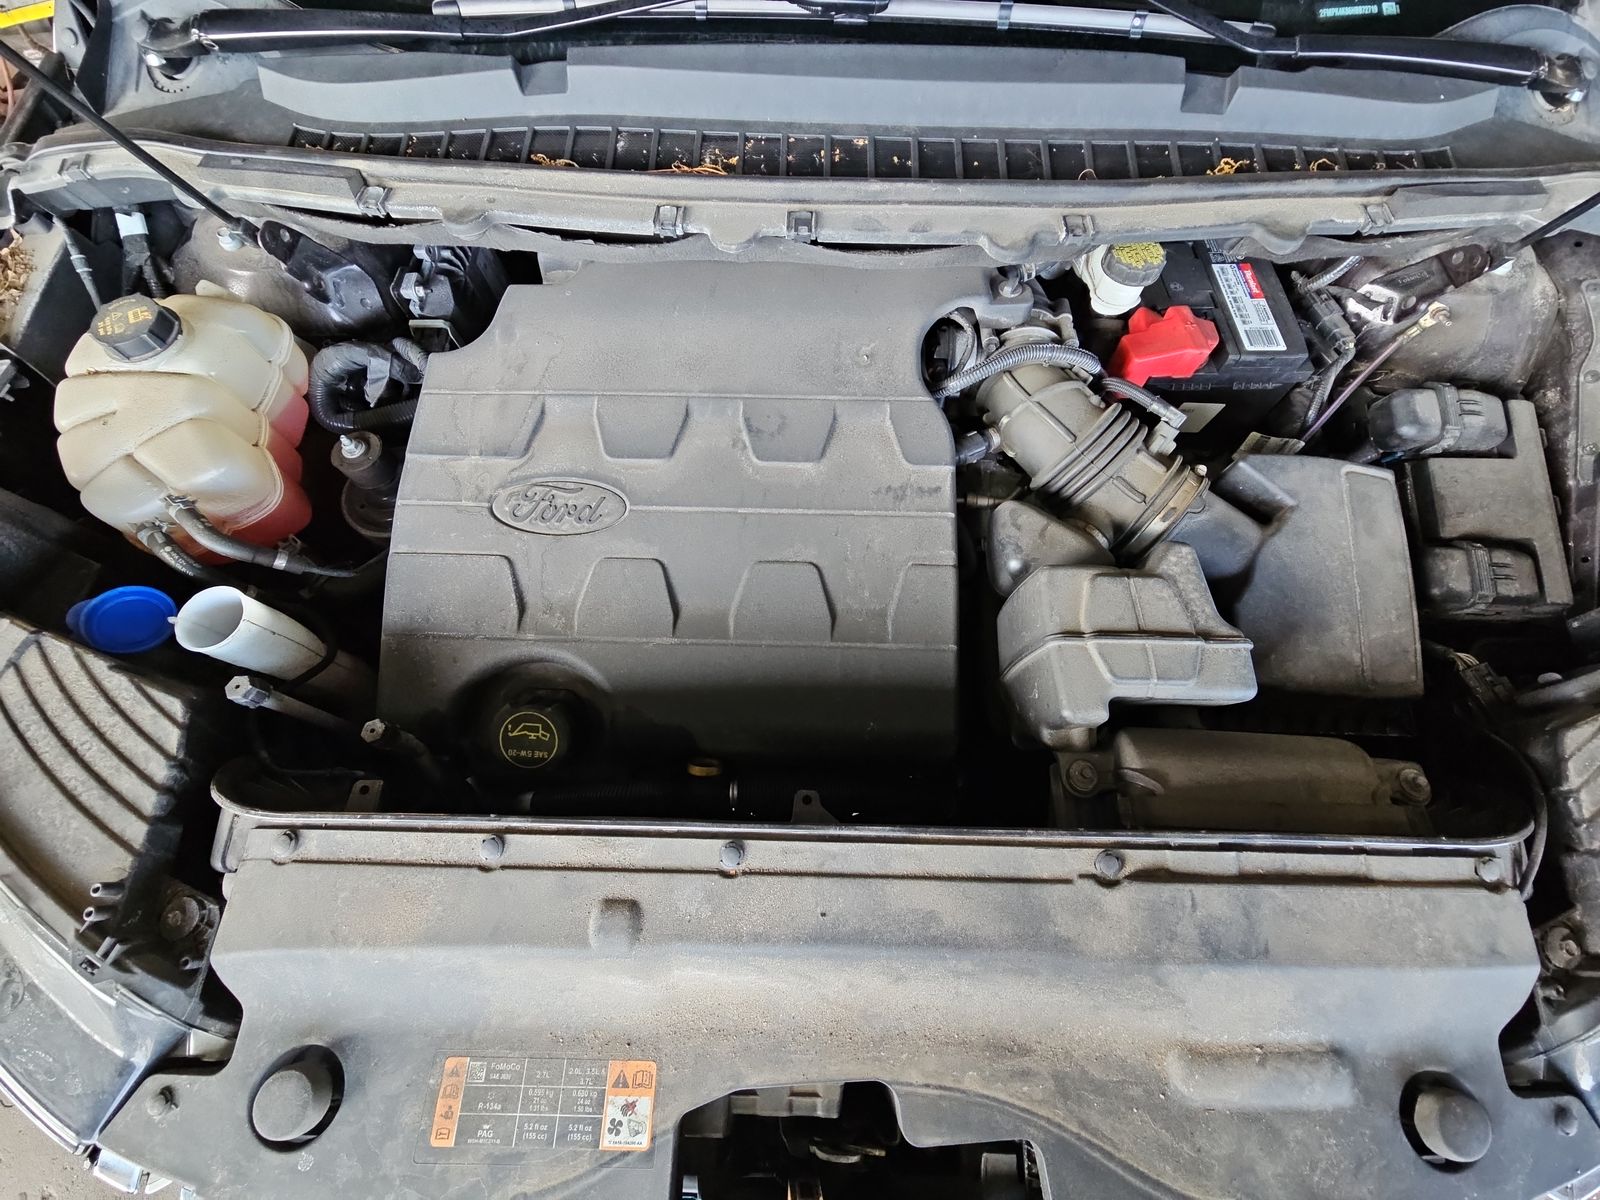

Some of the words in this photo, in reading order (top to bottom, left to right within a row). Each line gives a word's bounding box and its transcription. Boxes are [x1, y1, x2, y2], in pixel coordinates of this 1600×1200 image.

[508, 484, 606, 525] Ford
[507, 749, 532, 758] 5W-20
[534, 750, 549, 759] SAE
[490, 1062, 521, 1071] FoMoCo
[477, 1102, 502, 1111] R-134a
[523, 1122, 533, 1131] 5.2
[539, 1123, 549, 1131] oz
[568, 1123, 578, 1132] 5.2
[584, 1124, 593, 1132] oz
[476, 1129, 494, 1138] PAG
[522, 1132, 536, 1141] (155
[537, 1132, 548, 1141] cc)
[566, 1133, 581, 1142] (155
[581, 1133, 593, 1142] cc)
